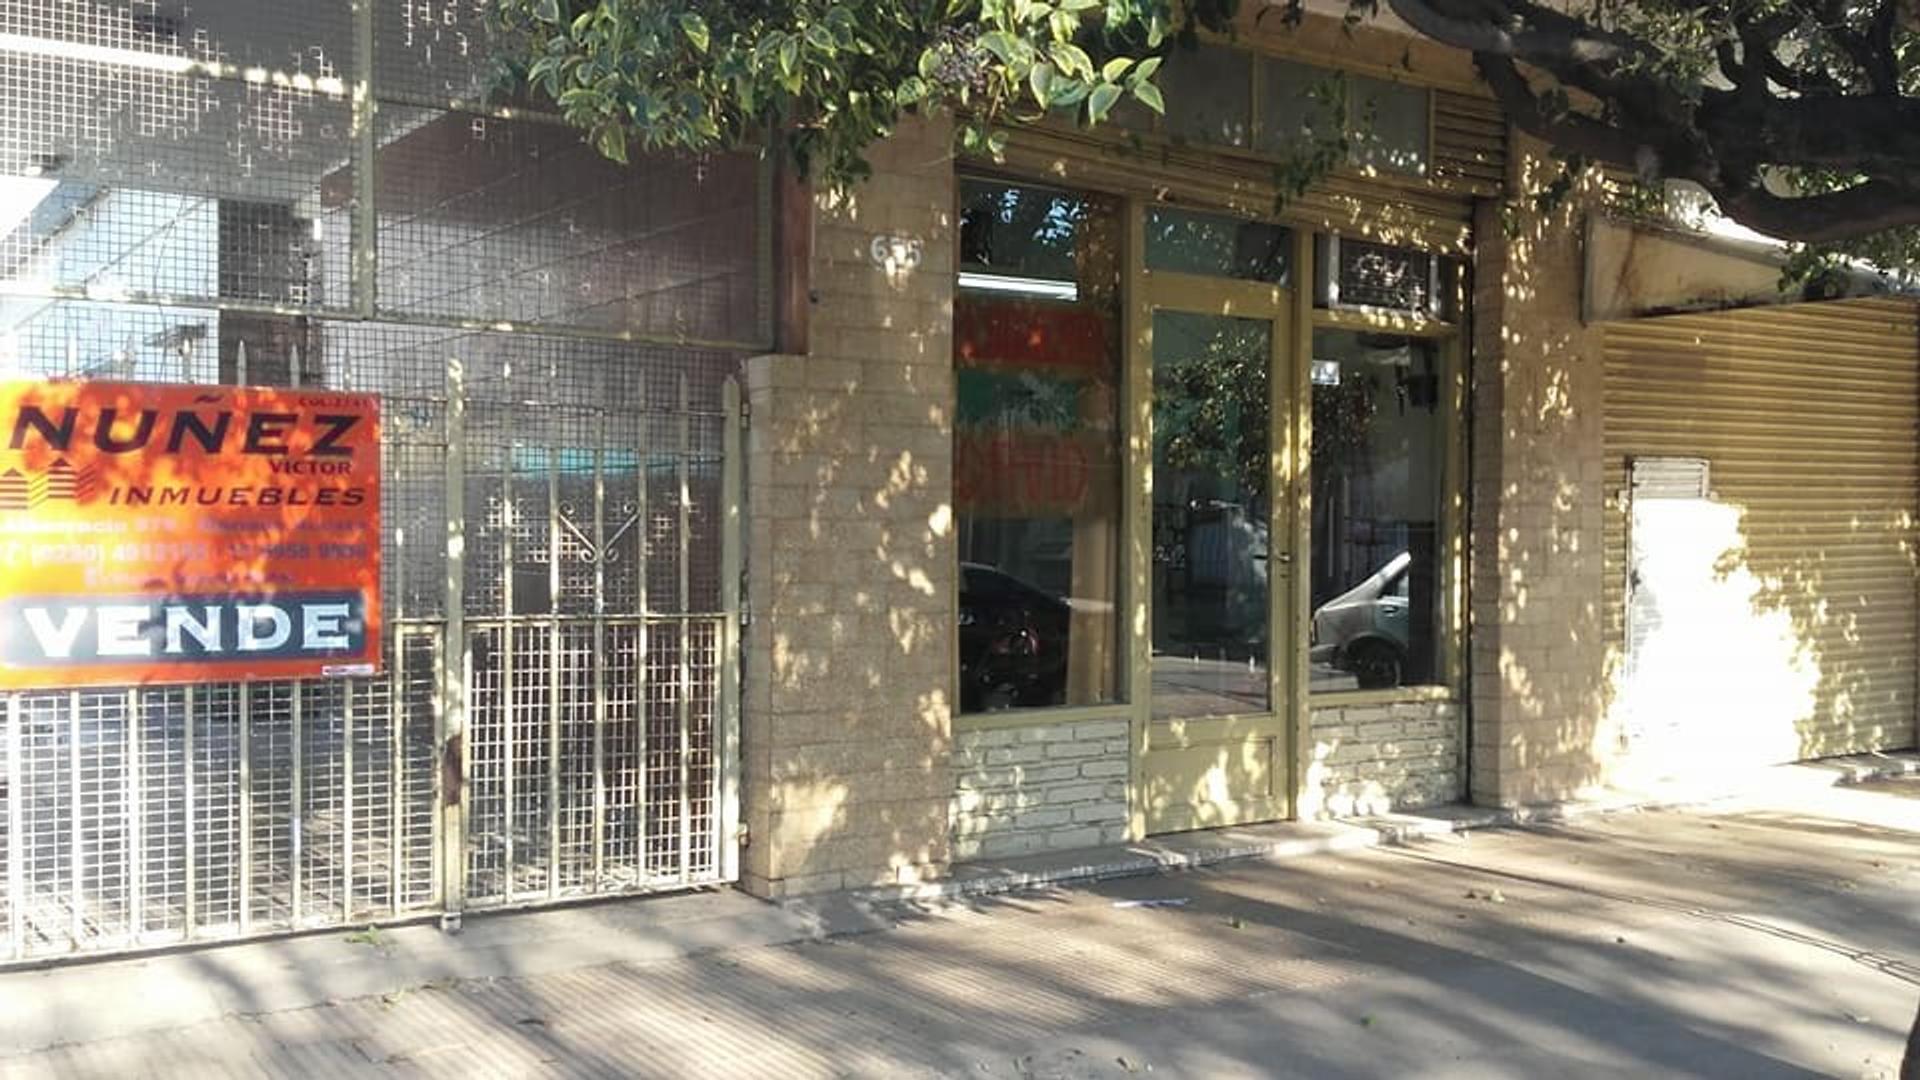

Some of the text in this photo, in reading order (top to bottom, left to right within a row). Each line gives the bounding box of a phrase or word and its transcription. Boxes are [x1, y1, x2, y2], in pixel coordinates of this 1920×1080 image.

[9, 394, 362, 456] NUÑEZ
[270, 458, 352, 476] VICTOR
[109, 486, 366, 507] INMUEBLES
[23, 603, 350, 658] VENDE
